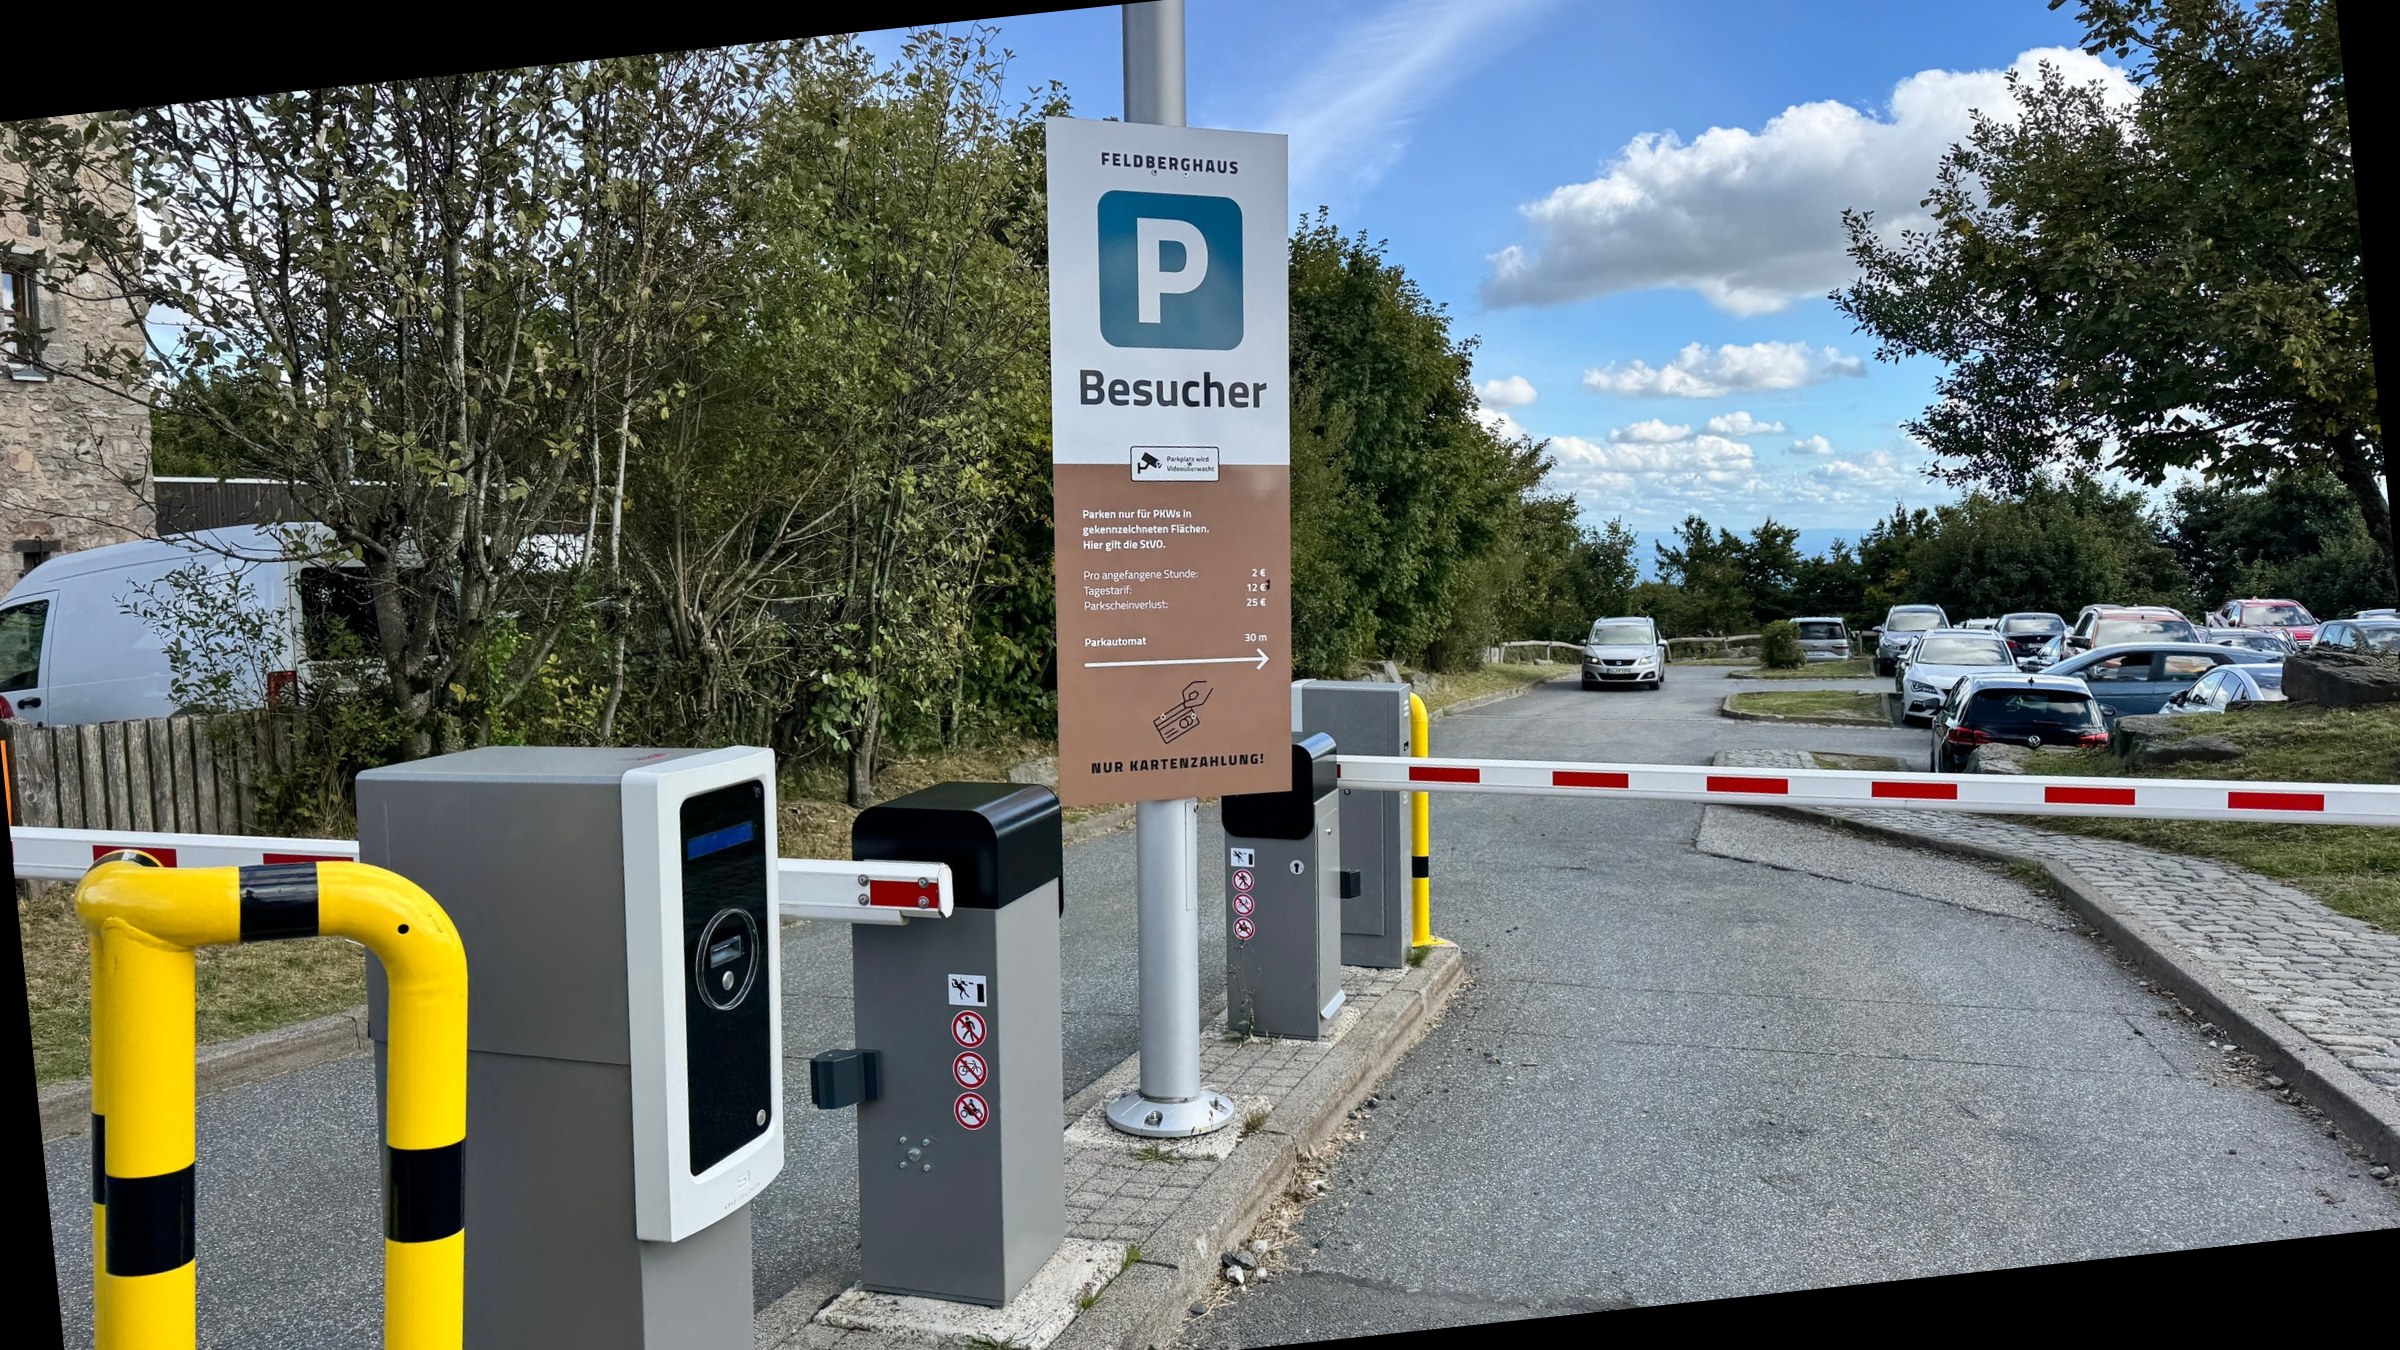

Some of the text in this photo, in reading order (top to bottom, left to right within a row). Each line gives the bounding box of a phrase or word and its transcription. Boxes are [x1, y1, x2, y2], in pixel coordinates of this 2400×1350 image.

[1101, 152, 1239, 174] FELDBERGHAUS
[1136, 218, 1209, 323] P
[1079, 369, 1267, 408] Besucher
[1082, 509, 1191, 519] Parken nur für PKWs in
[1083, 524, 1209, 537] gekennzeichneten Flächen.
[1083, 540, 1166, 551] Hier gilt die StVO.
[1084, 569, 1266, 582] Pro angefangene Stunde: 2 €
[1084, 583, 1266, 597] Tagestarif: 12 €
[1084, 598, 1266, 610] Parkscheinverlust: 25 €
[1084, 637, 1147, 647] Parkautomat
[1245, 633, 1256, 642] 30
[1091, 753, 1264, 773] NUR KARTENZAHLUNG!
